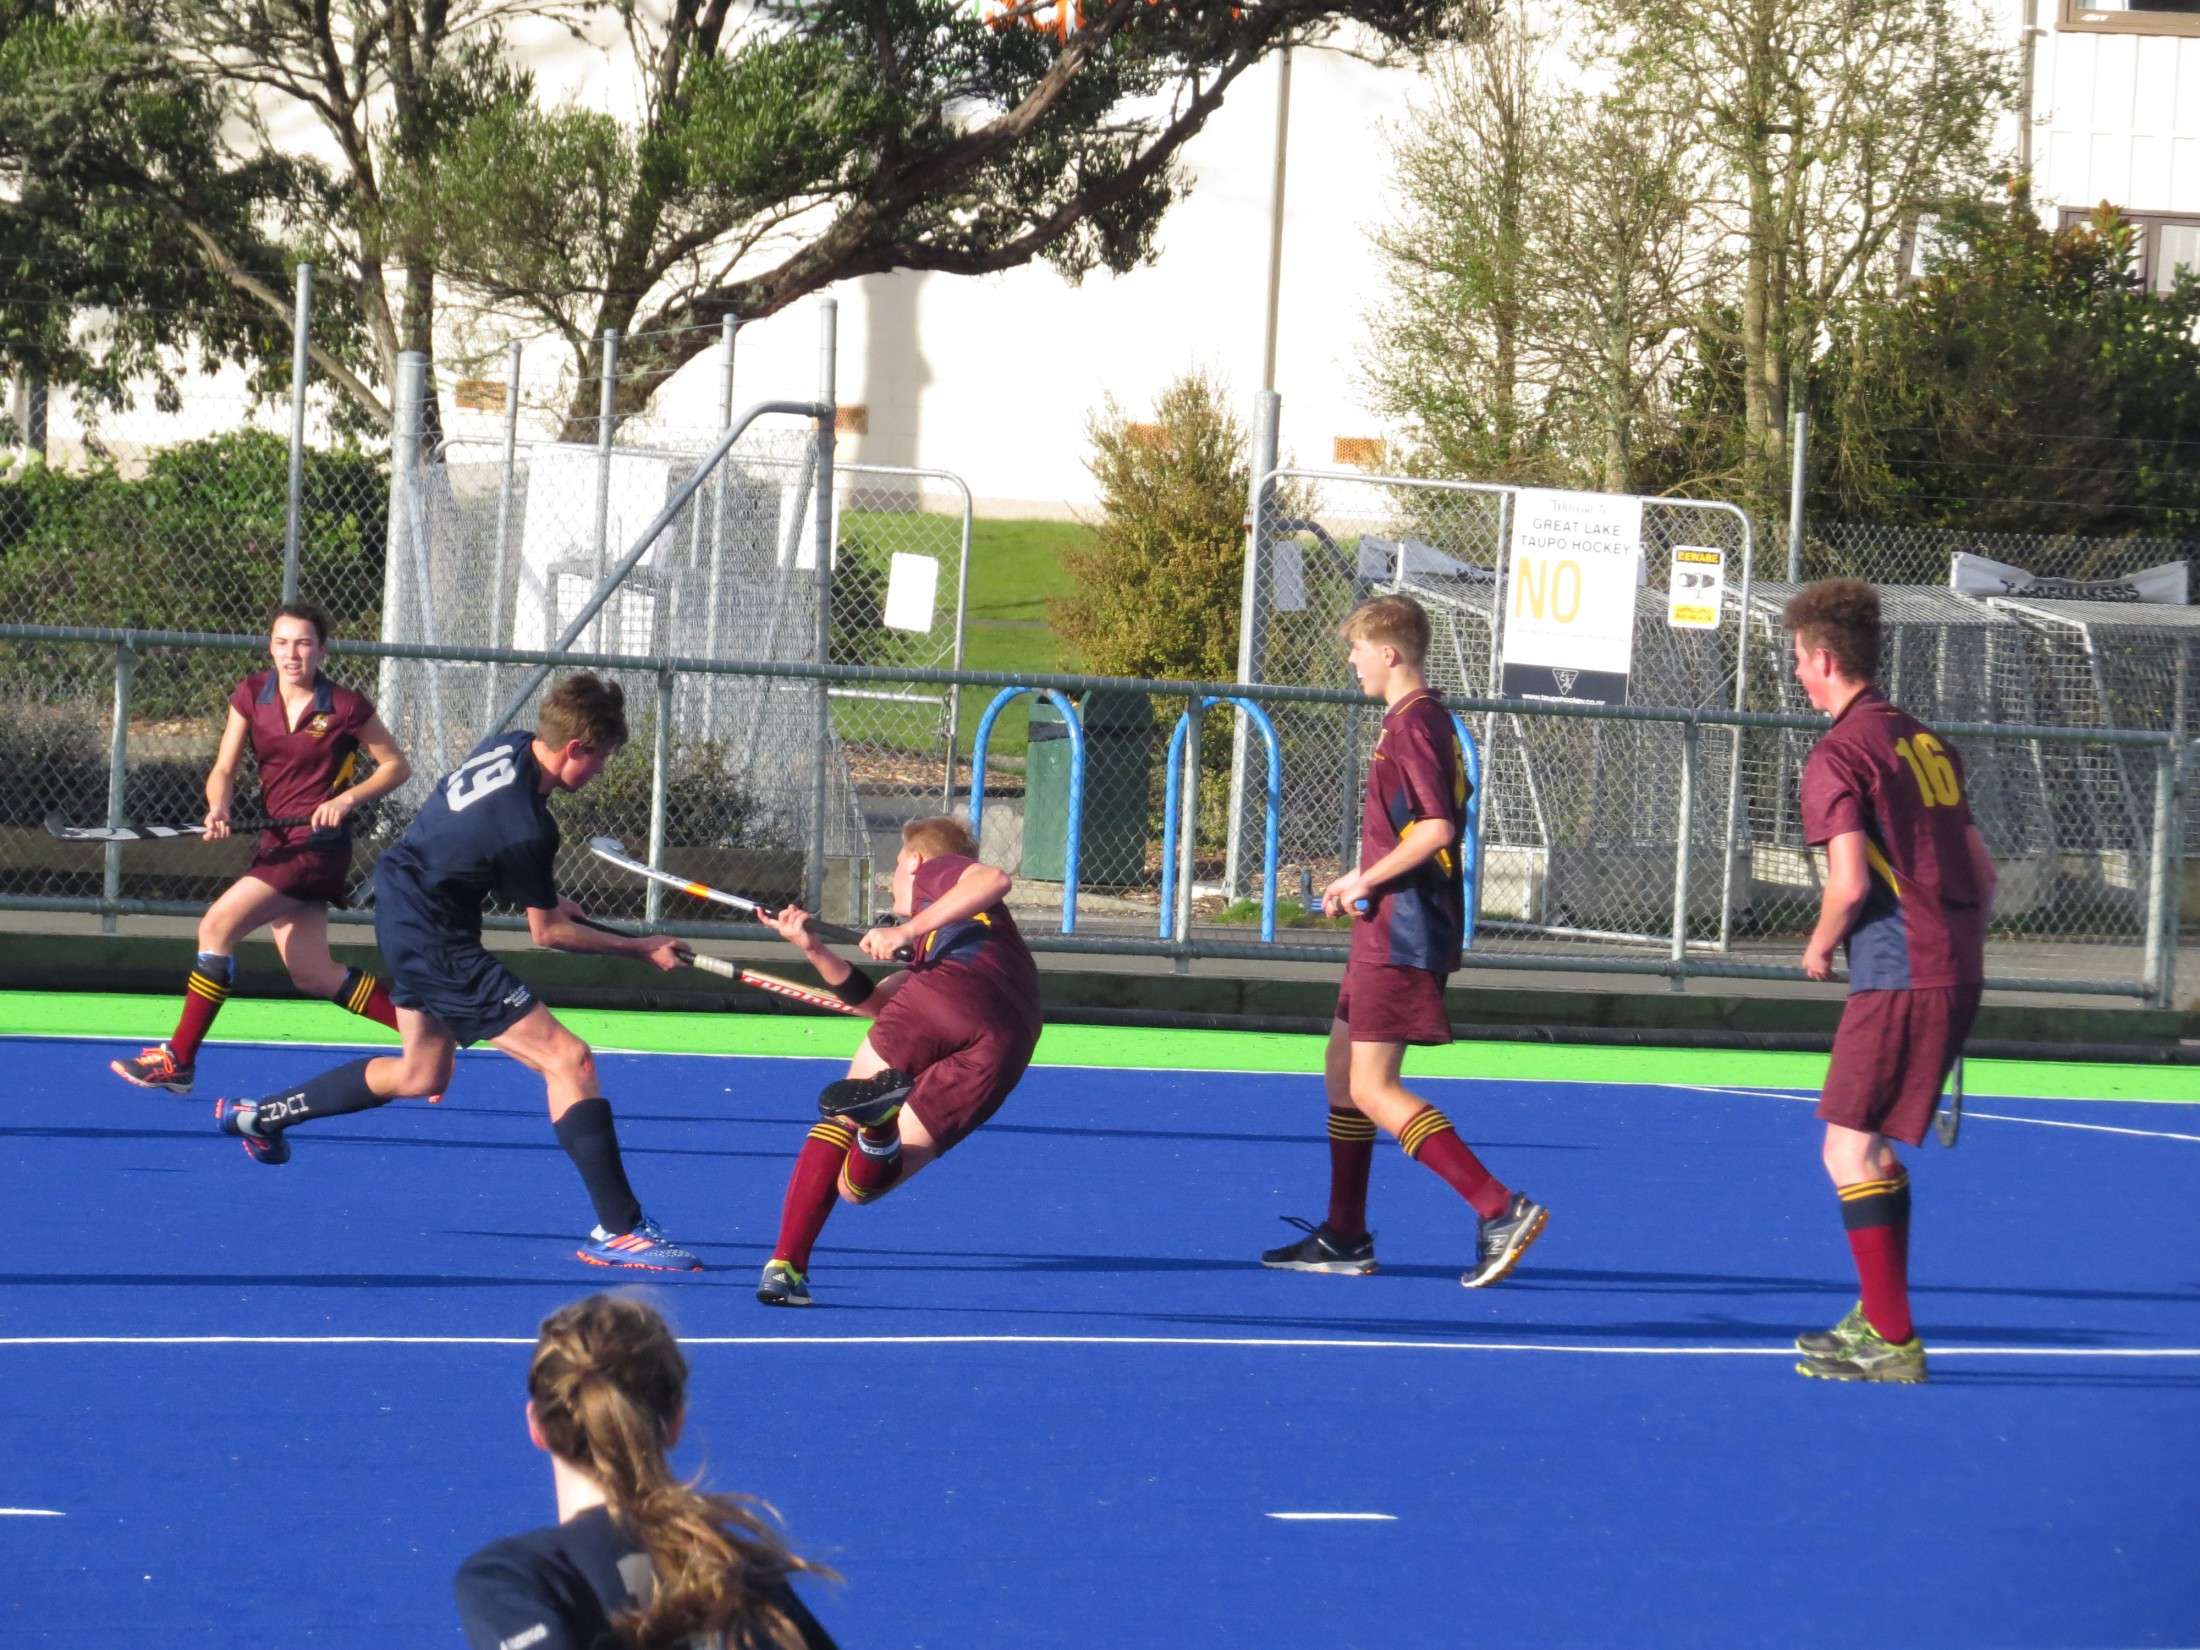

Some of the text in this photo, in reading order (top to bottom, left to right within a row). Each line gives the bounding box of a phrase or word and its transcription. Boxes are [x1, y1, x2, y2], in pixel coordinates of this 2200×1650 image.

[1521, 534, 1631, 556] TAUPO HOCKEY
[1532, 518, 1621, 537] GREAT LAKE
[1514, 556, 1582, 623] NO
[446, 744, 516, 812] 19
[1894, 732, 1960, 808] 16
